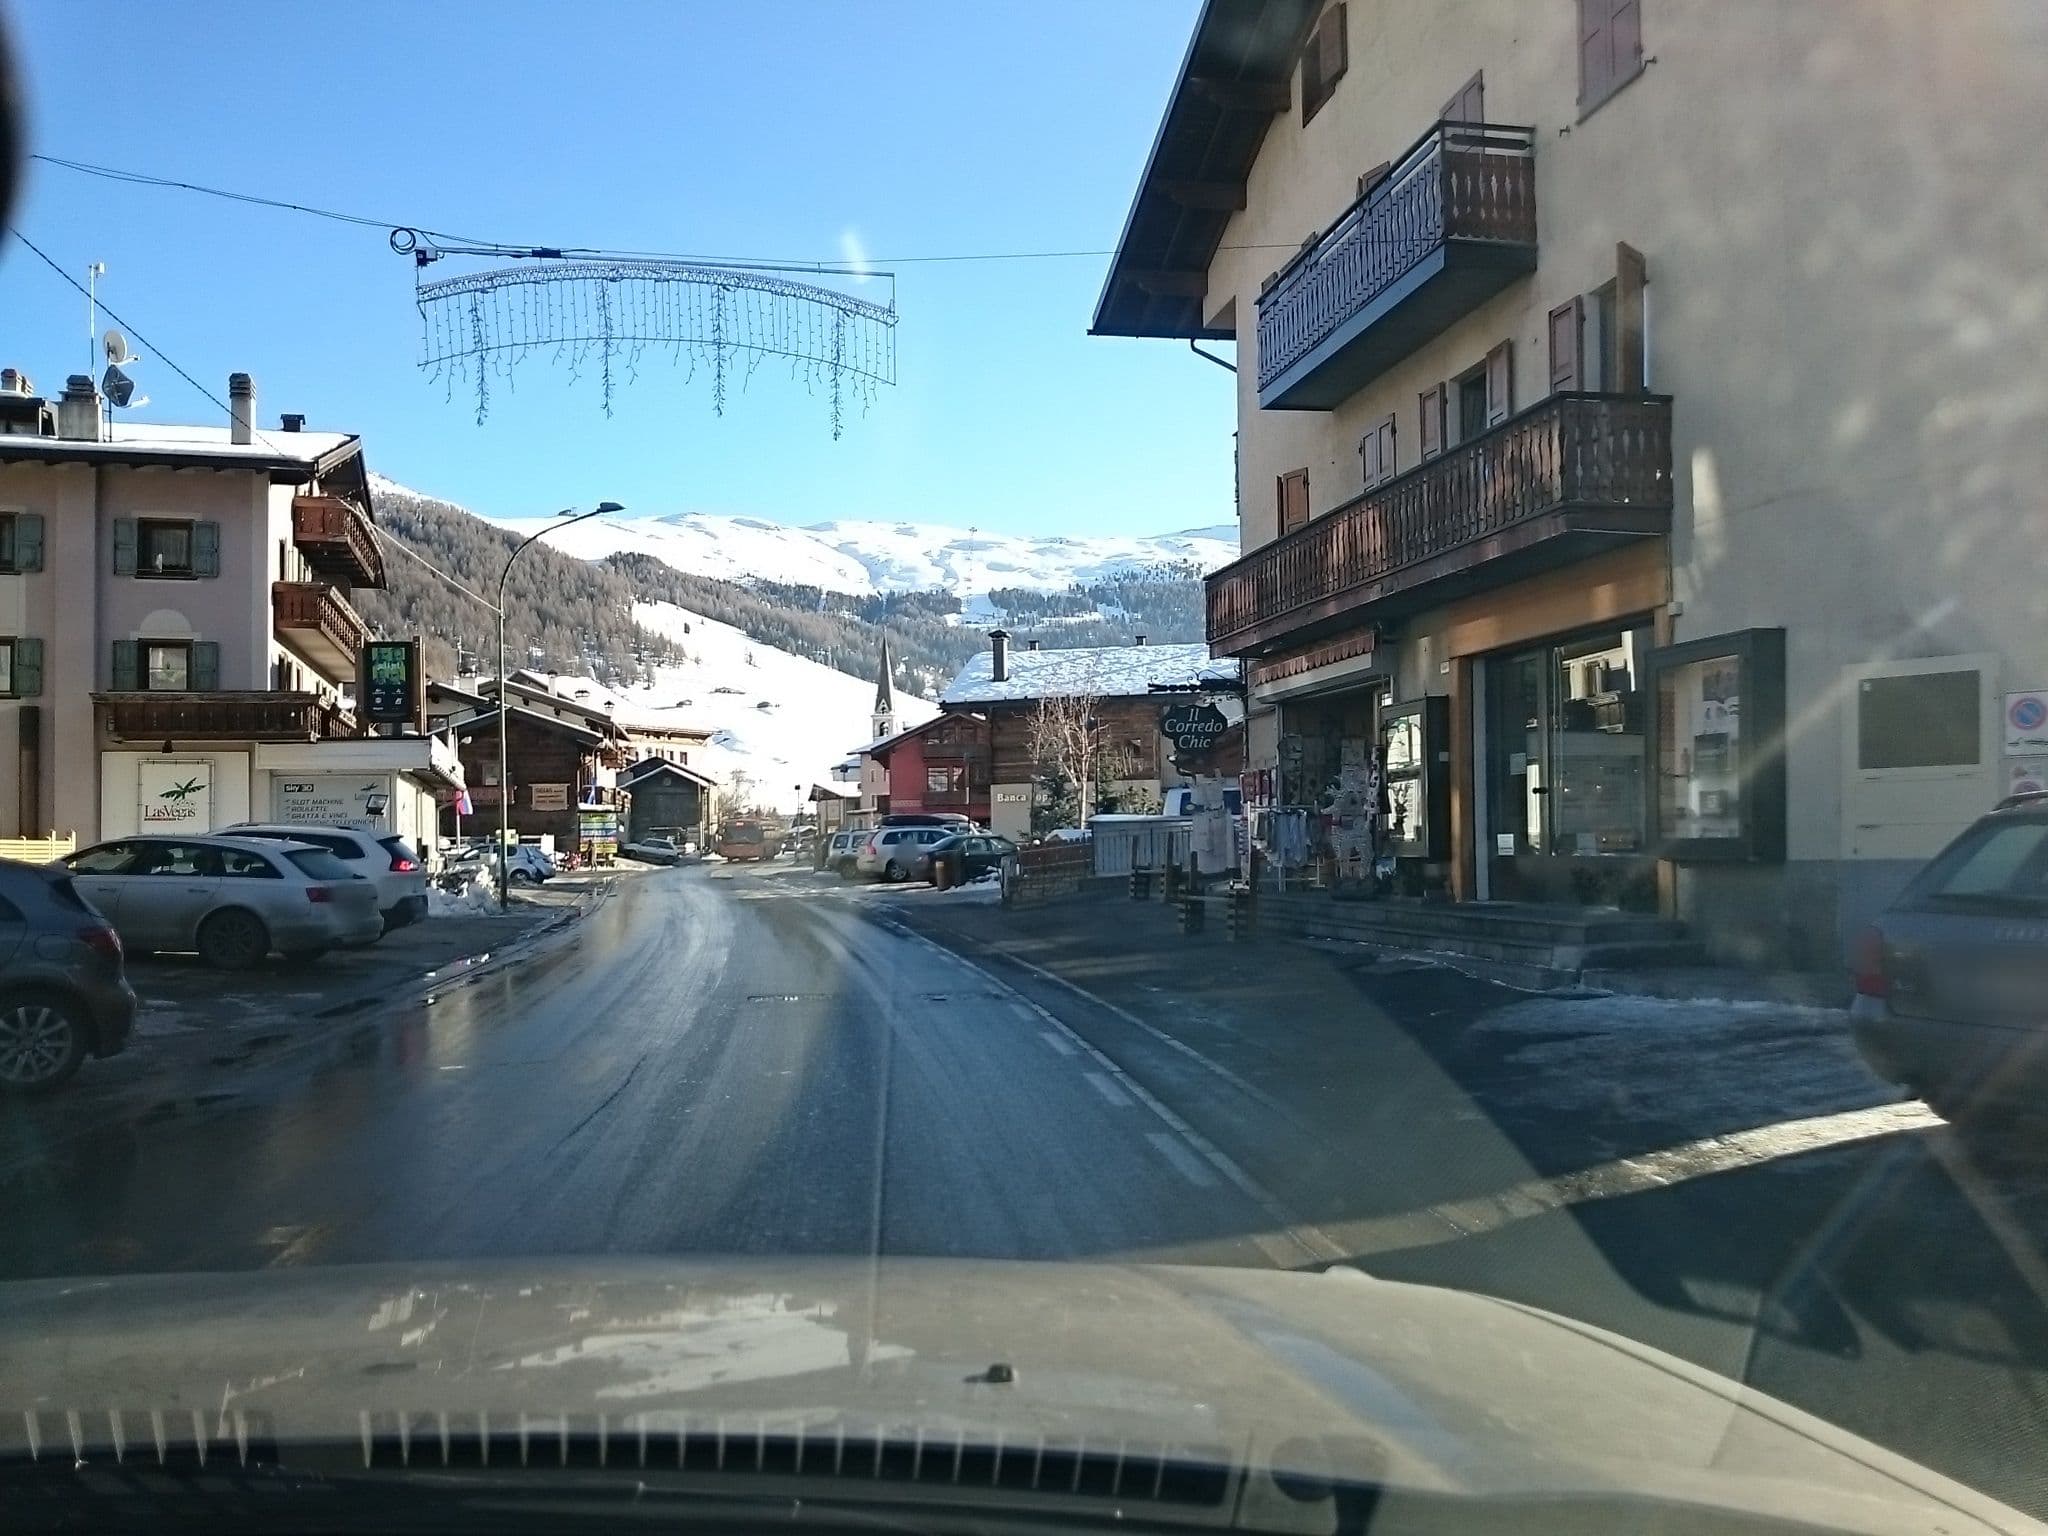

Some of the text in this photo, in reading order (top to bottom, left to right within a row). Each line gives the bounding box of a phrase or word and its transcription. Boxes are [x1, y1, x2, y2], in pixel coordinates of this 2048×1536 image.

[1188, 708, 1200, 721] Il
[1164, 718, 1223, 732] Corredo
[1178, 735, 1211, 748] Chic
[997, 793, 1027, 802] Banca
